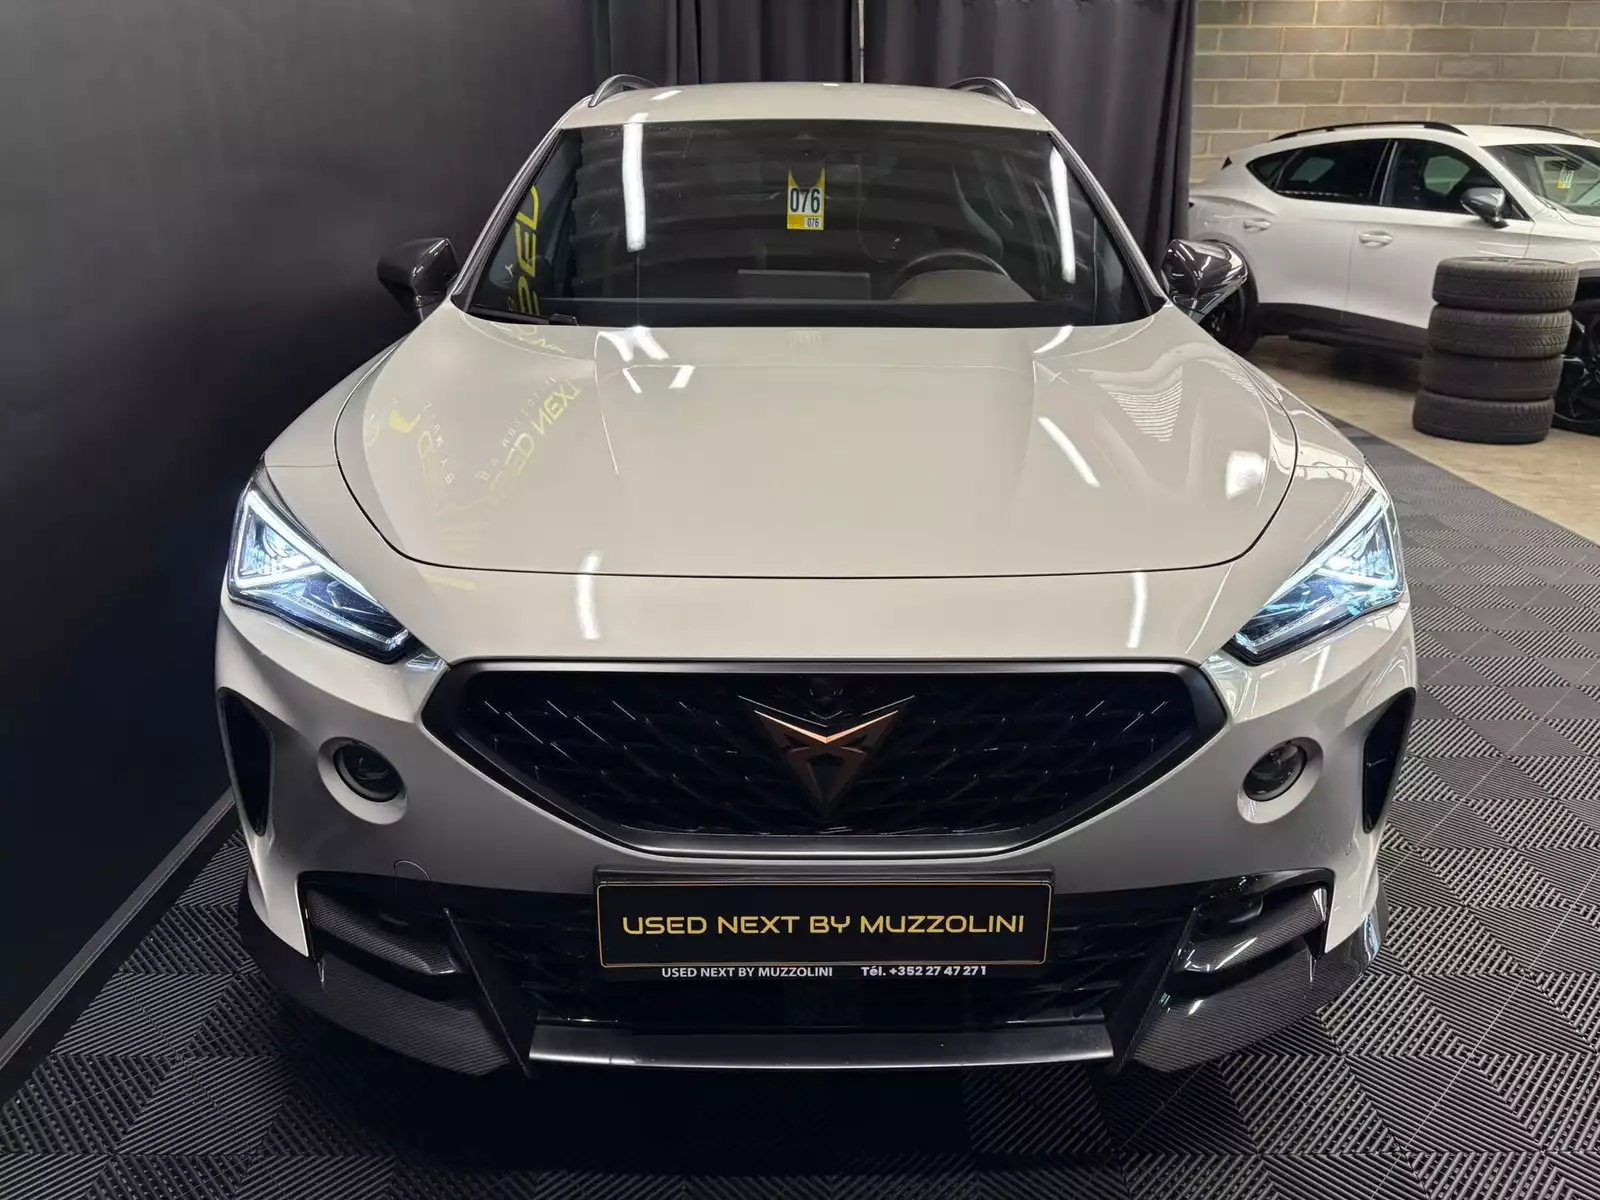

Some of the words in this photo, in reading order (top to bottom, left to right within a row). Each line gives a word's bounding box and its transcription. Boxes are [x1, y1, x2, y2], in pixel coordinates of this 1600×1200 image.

[790, 187, 820, 213] 076
[807, 217, 819, 228] 076
[622, 916, 708, 934] USED
[717, 915, 801, 934] NEXT
[809, 915, 850, 934] BY
[860, 915, 1025, 934] MUZZOLINI
[661, 966, 697, 978] USED
[700, 966, 735, 977] NEXT
[738, 966, 755, 977] BY
[758, 966, 833, 977] MUZZOLINI
[861, 965, 887, 976] Tél.
[889, 966, 924, 976] +352
[925, 966, 940, 976] 27
[943, 966, 959, 976] 47
